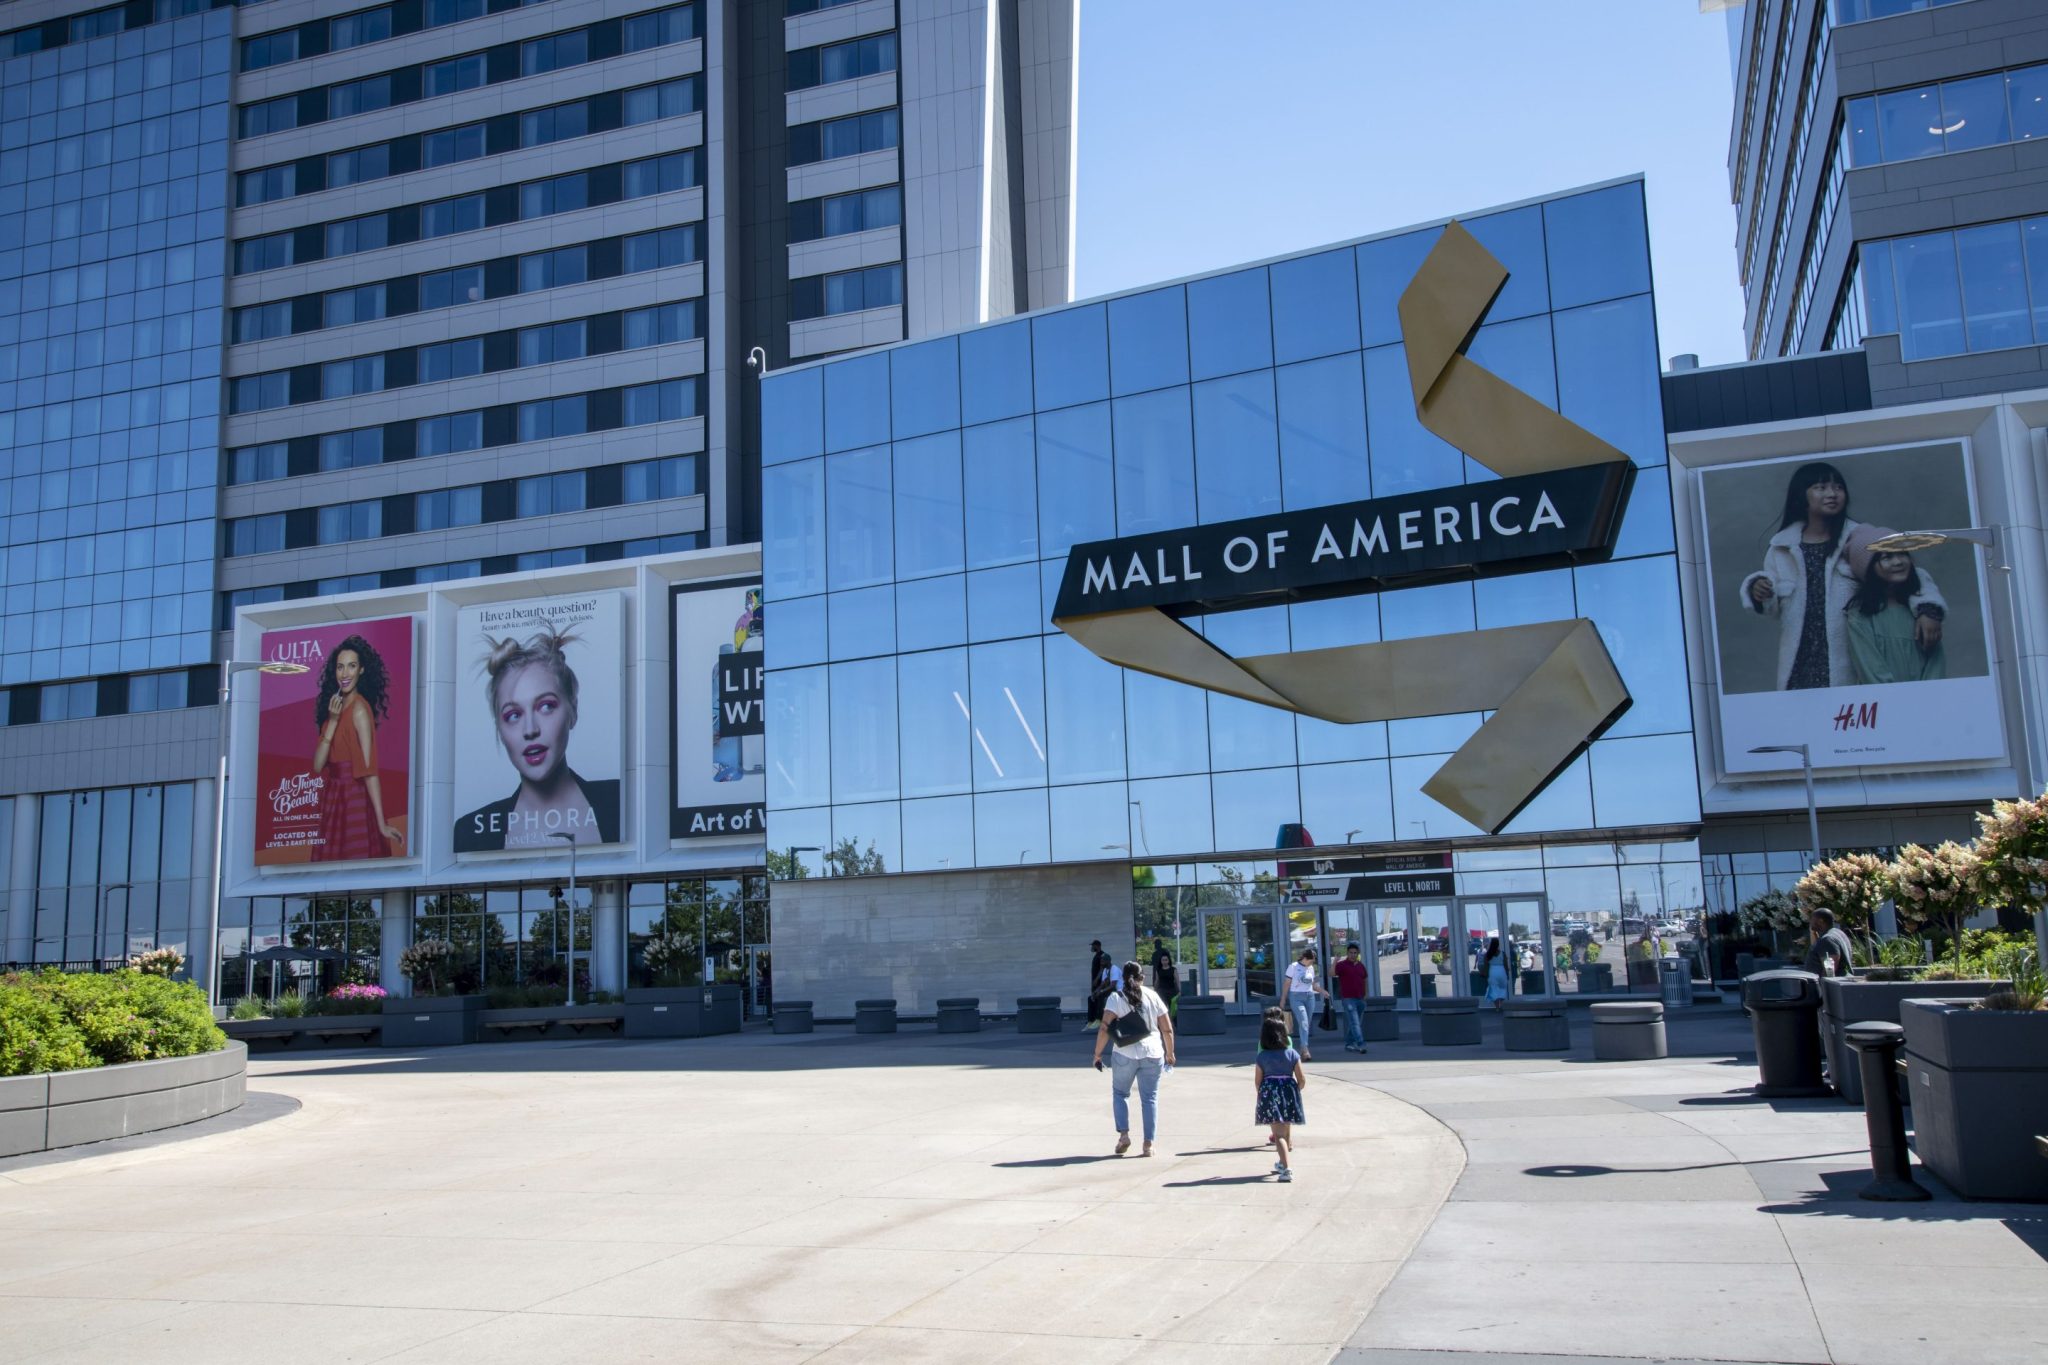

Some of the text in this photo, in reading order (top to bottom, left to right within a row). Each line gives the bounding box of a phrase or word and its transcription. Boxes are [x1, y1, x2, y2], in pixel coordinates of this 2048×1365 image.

[1082, 490, 1566, 596] MALL OF AMERICA
[480, 600, 597, 622] Have a beauty question?
[278, 640, 322, 660] ULTA
[1833, 701, 1878, 731] H&M
[269, 772, 324, 800] All Things
[474, 806, 598, 834] SEPHORA
[690, 812, 725, 833] Art
[730, 808, 753, 830] of
[274, 830, 319, 840] LOCATED ON
[1384, 880, 1440, 893] LEVEL 1, NORTH
